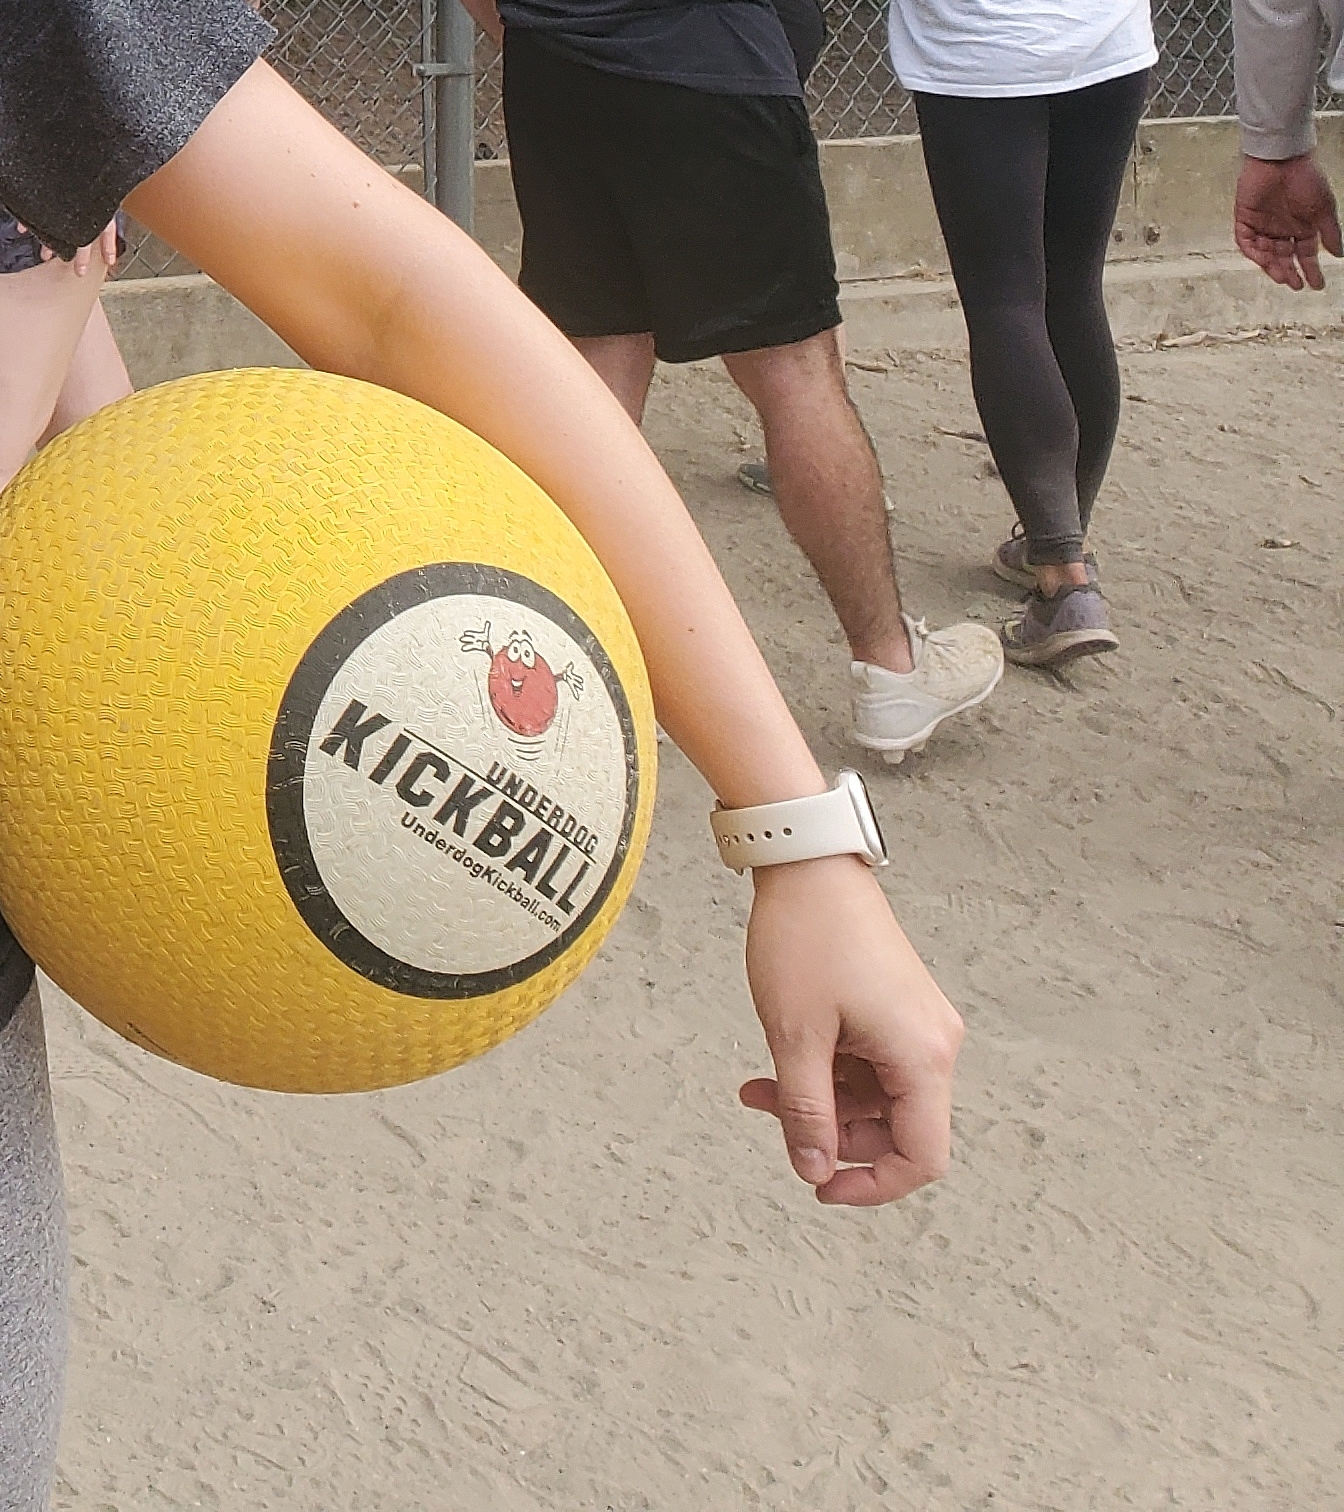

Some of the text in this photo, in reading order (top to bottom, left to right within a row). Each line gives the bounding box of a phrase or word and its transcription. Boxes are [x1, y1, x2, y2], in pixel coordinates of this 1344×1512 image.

[319, 698, 591, 916] KICKBALL
[485, 760, 600, 856] UNDERDOG
[401, 811, 561, 934] UnderdogKickball.com
